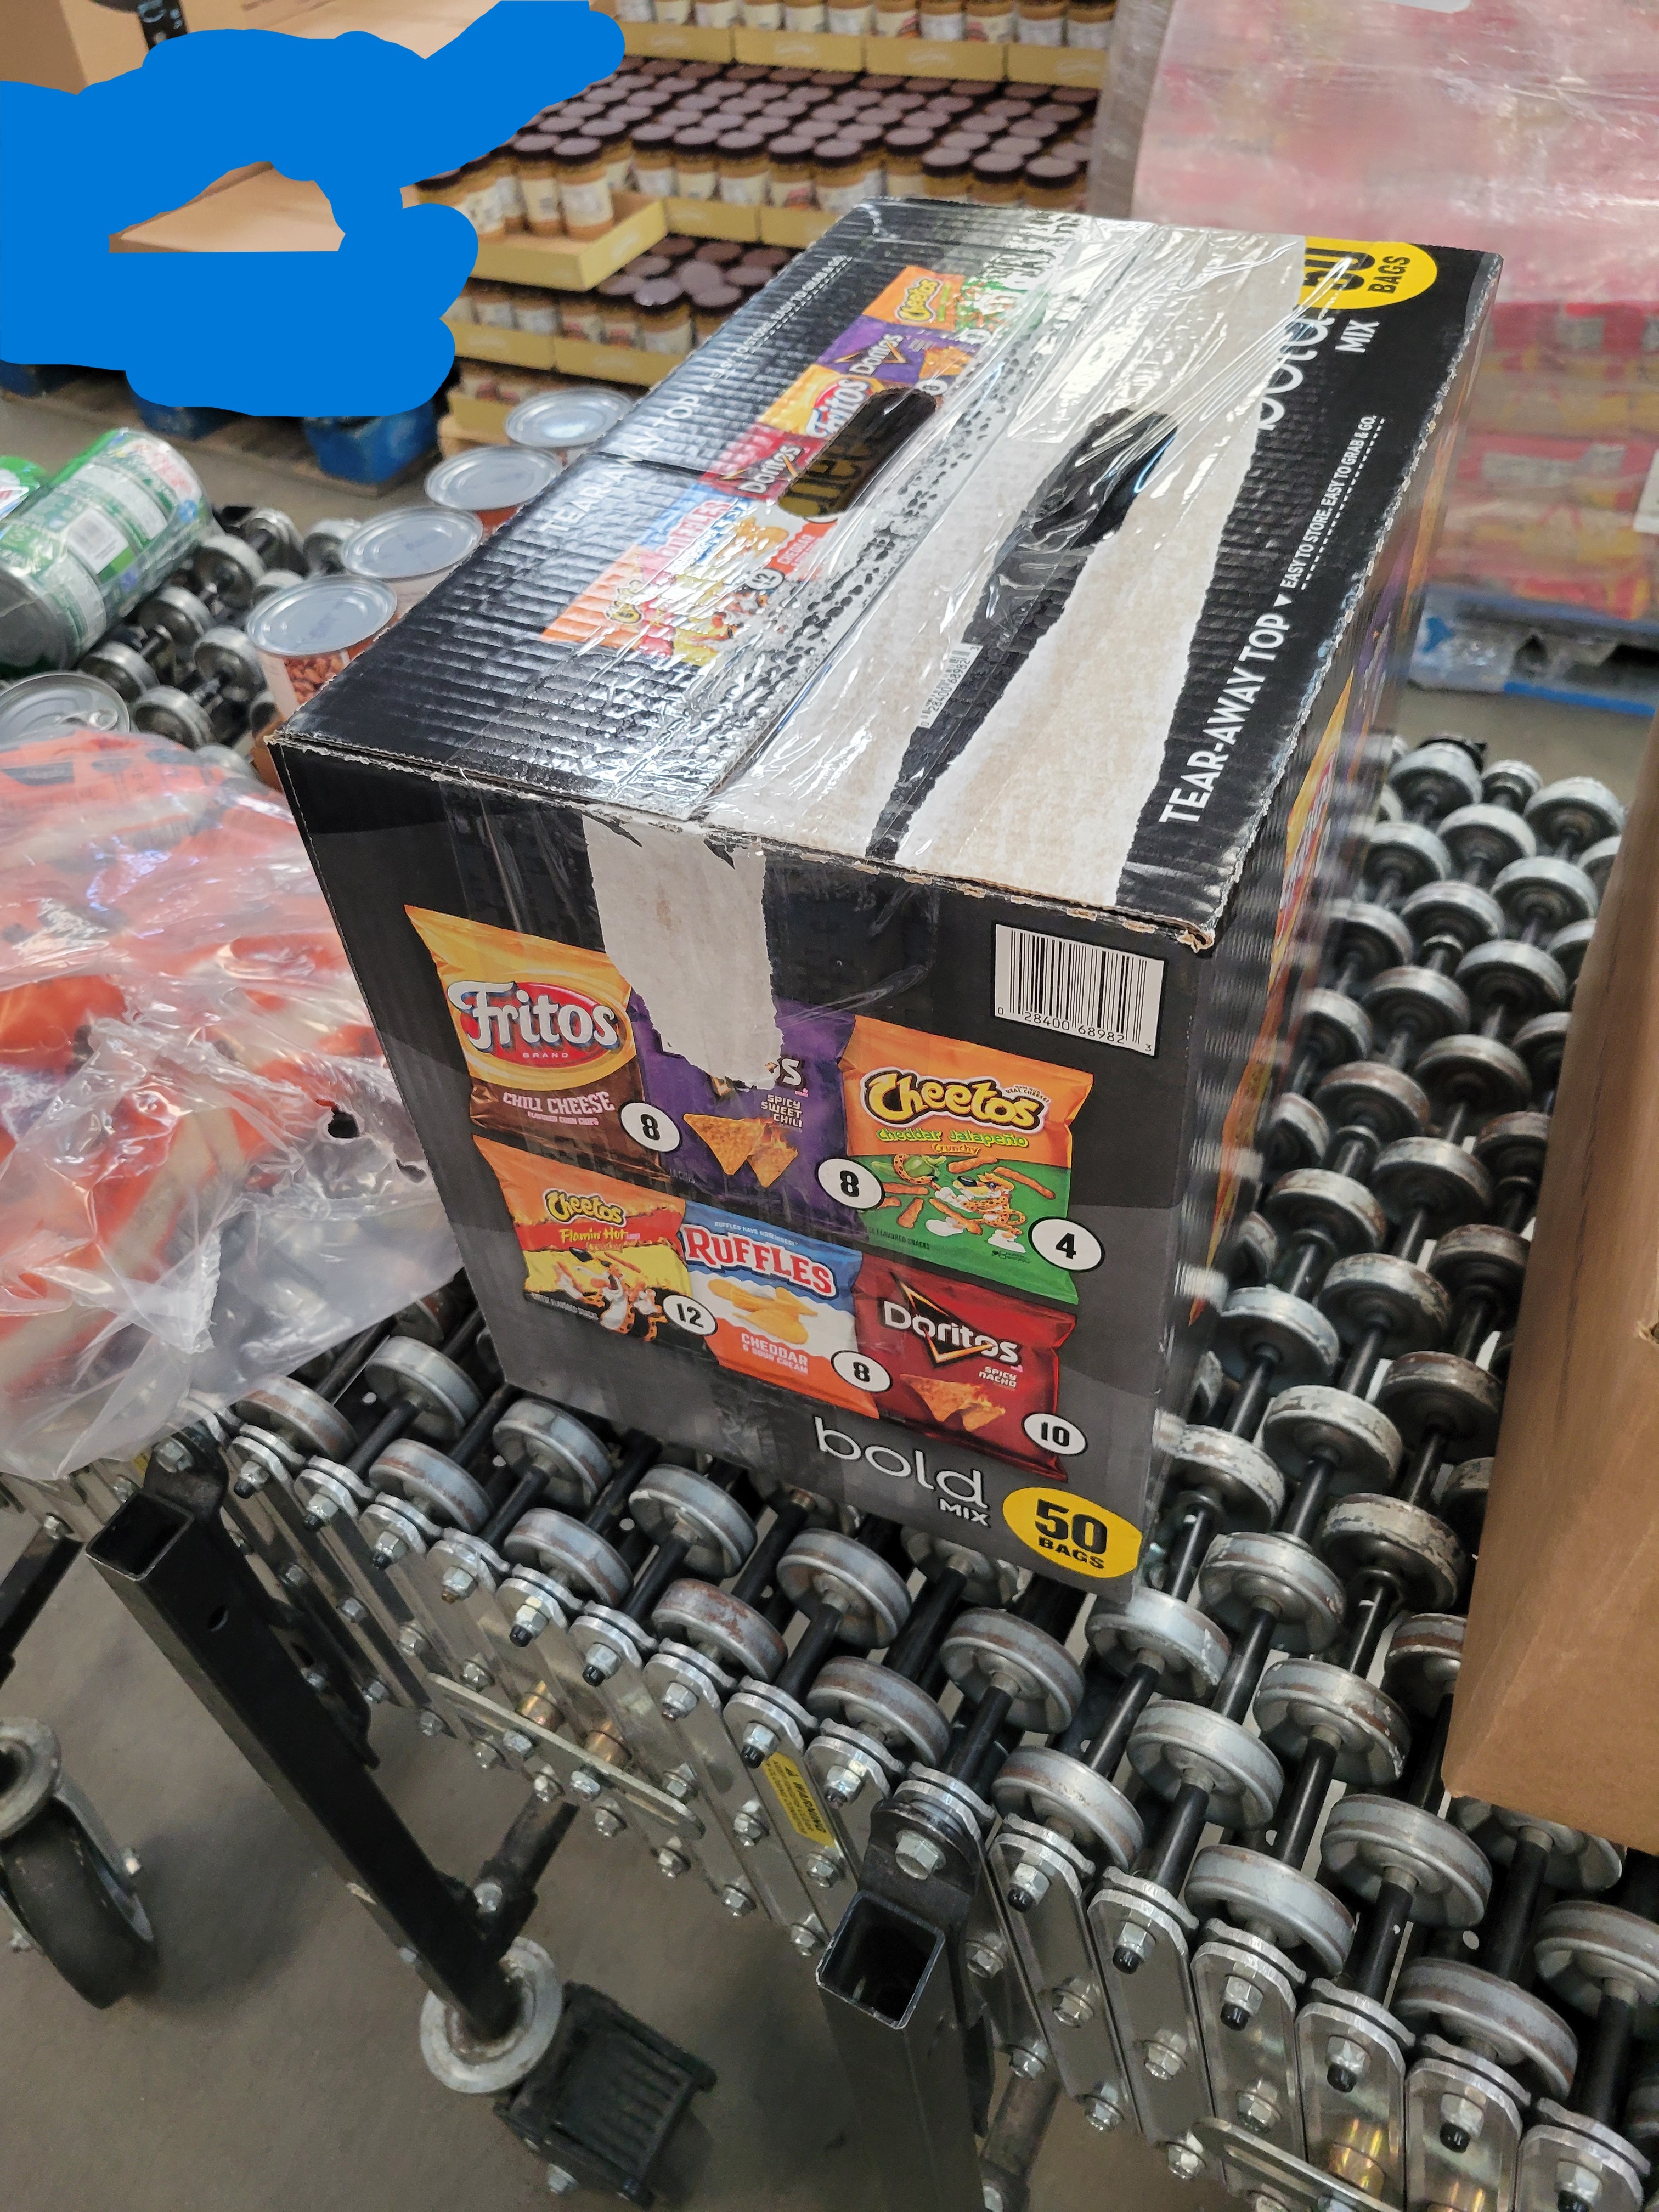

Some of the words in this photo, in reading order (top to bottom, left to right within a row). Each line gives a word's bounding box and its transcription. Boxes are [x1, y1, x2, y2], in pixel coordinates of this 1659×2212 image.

[1367, 255, 1410, 294] BAGS
[790, 291, 808, 302] TO
[899, 278, 940, 321] Cheetos
[1335, 319, 1380, 353] MIX
[849, 334, 904, 375] Doritos
[652, 396, 701, 427] TOP
[805, 379, 870, 438] Fritos
[1354, 431, 1368, 441] &
[1358, 415, 1378, 432] GO.
[1341, 439, 1367, 466] GRAB
[738, 445, 802, 494] Doritos
[1333, 466, 1352, 482] TO
[1321, 481, 1345, 506] EASY
[1303, 508, 1332, 544] STORE.
[777, 534, 816, 565] CHEDDAR
[1294, 543, 1316, 559] TO
[752, 572, 777, 584] 12
[1280, 558, 1307, 589] EASY
[928, 686, 952, 712] 28400
[947, 659, 971, 684] 68982
[1158, 666, 1265, 822] TEAR-AWAY
[1238, 613, 1291, 661] TOP
[447, 981, 620, 1050] Fritos
[997, 1007, 1004, 1015] 0
[1024, 1012, 1070, 1031] 28400
[1078, 1025, 1125, 1044] 68982
[1144, 1043, 1152, 1052] 3
[503, 1092, 543, 1113] CHILI
[547, 1091, 616, 1115] CHEESE
[761, 1101, 803, 1119] SWEET
[767, 1094, 801, 1110] SPICY
[867, 1070, 1042, 1130] Cheetos
[640, 1114, 661, 1141] 8
[773, 1114, 803, 1128] CHILI
[876, 1128, 941, 1142] Cheddar
[949, 1128, 1029, 1148] Jalapeño
[932, 1142, 981, 1155] Crunchy
[839, 1169, 860, 1198] 8
[546, 1190, 624, 1225] Cheetos
[559, 1228, 601, 1243] Flamin'
[604, 1227, 627, 1240] Hot
[714, 1221, 741, 1231] RUFFLES
[742, 1226, 758, 1235] HAVE
[1055, 1232, 1077, 1260] 4
[684, 1227, 833, 1295] RUFFLES
[676, 1303, 704, 1328] 12
[883, 1300, 1019, 1364] Doritos
[741, 1333, 808, 1367] CHEDDAR
[752, 1347, 775, 1361] SOUR
[777, 1357, 808, 1374] CREAM
[853, 1362, 871, 1383] 8
[979, 1370, 1017, 1388] NACHO
[985, 1366, 1017, 1381] SPICY
[1041, 1421, 1070, 1448] 10
[814, 1416, 988, 1509] bold
[940, 1499, 990, 1527] MIX
[1035, 1499, 1108, 1556] 50
[1039, 1536, 1105, 1570] BAGS
[793, 1781, 827, 1833] WARNING
